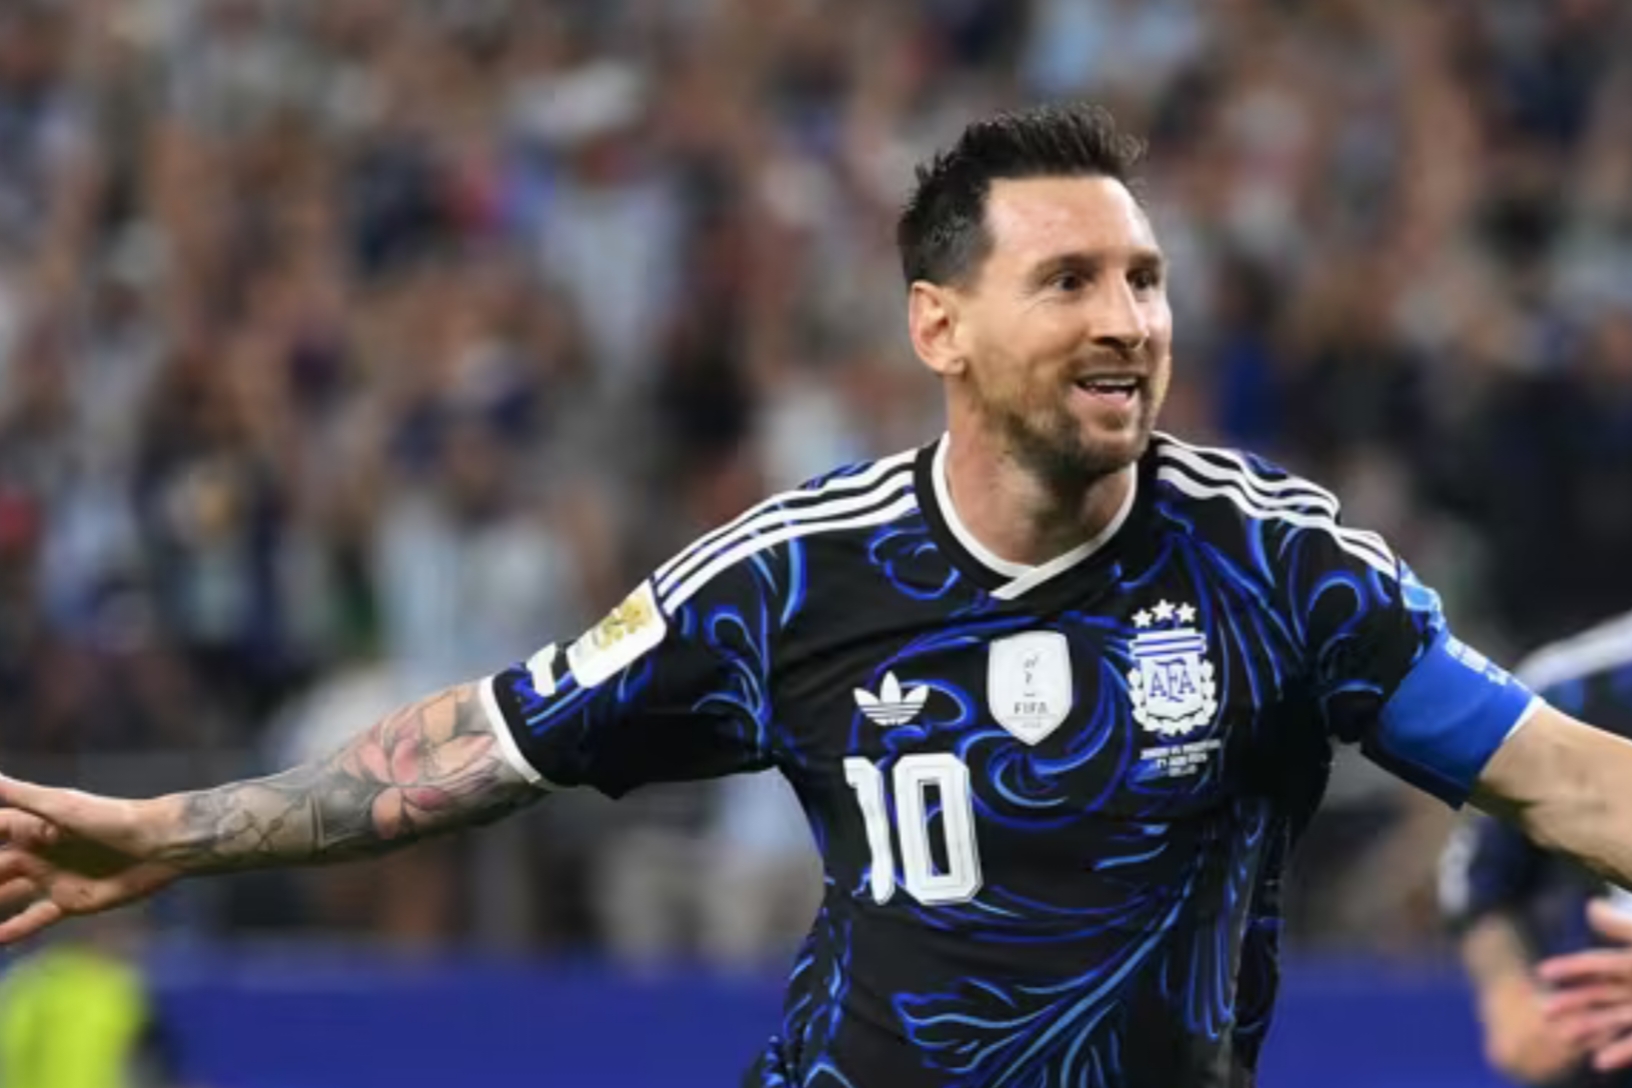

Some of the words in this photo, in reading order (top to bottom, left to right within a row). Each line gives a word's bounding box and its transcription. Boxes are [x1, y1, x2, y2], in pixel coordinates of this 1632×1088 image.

[1149, 657, 1197, 702] AFA
[1013, 701, 1049, 714] FIFA
[843, 753, 983, 905] 10
